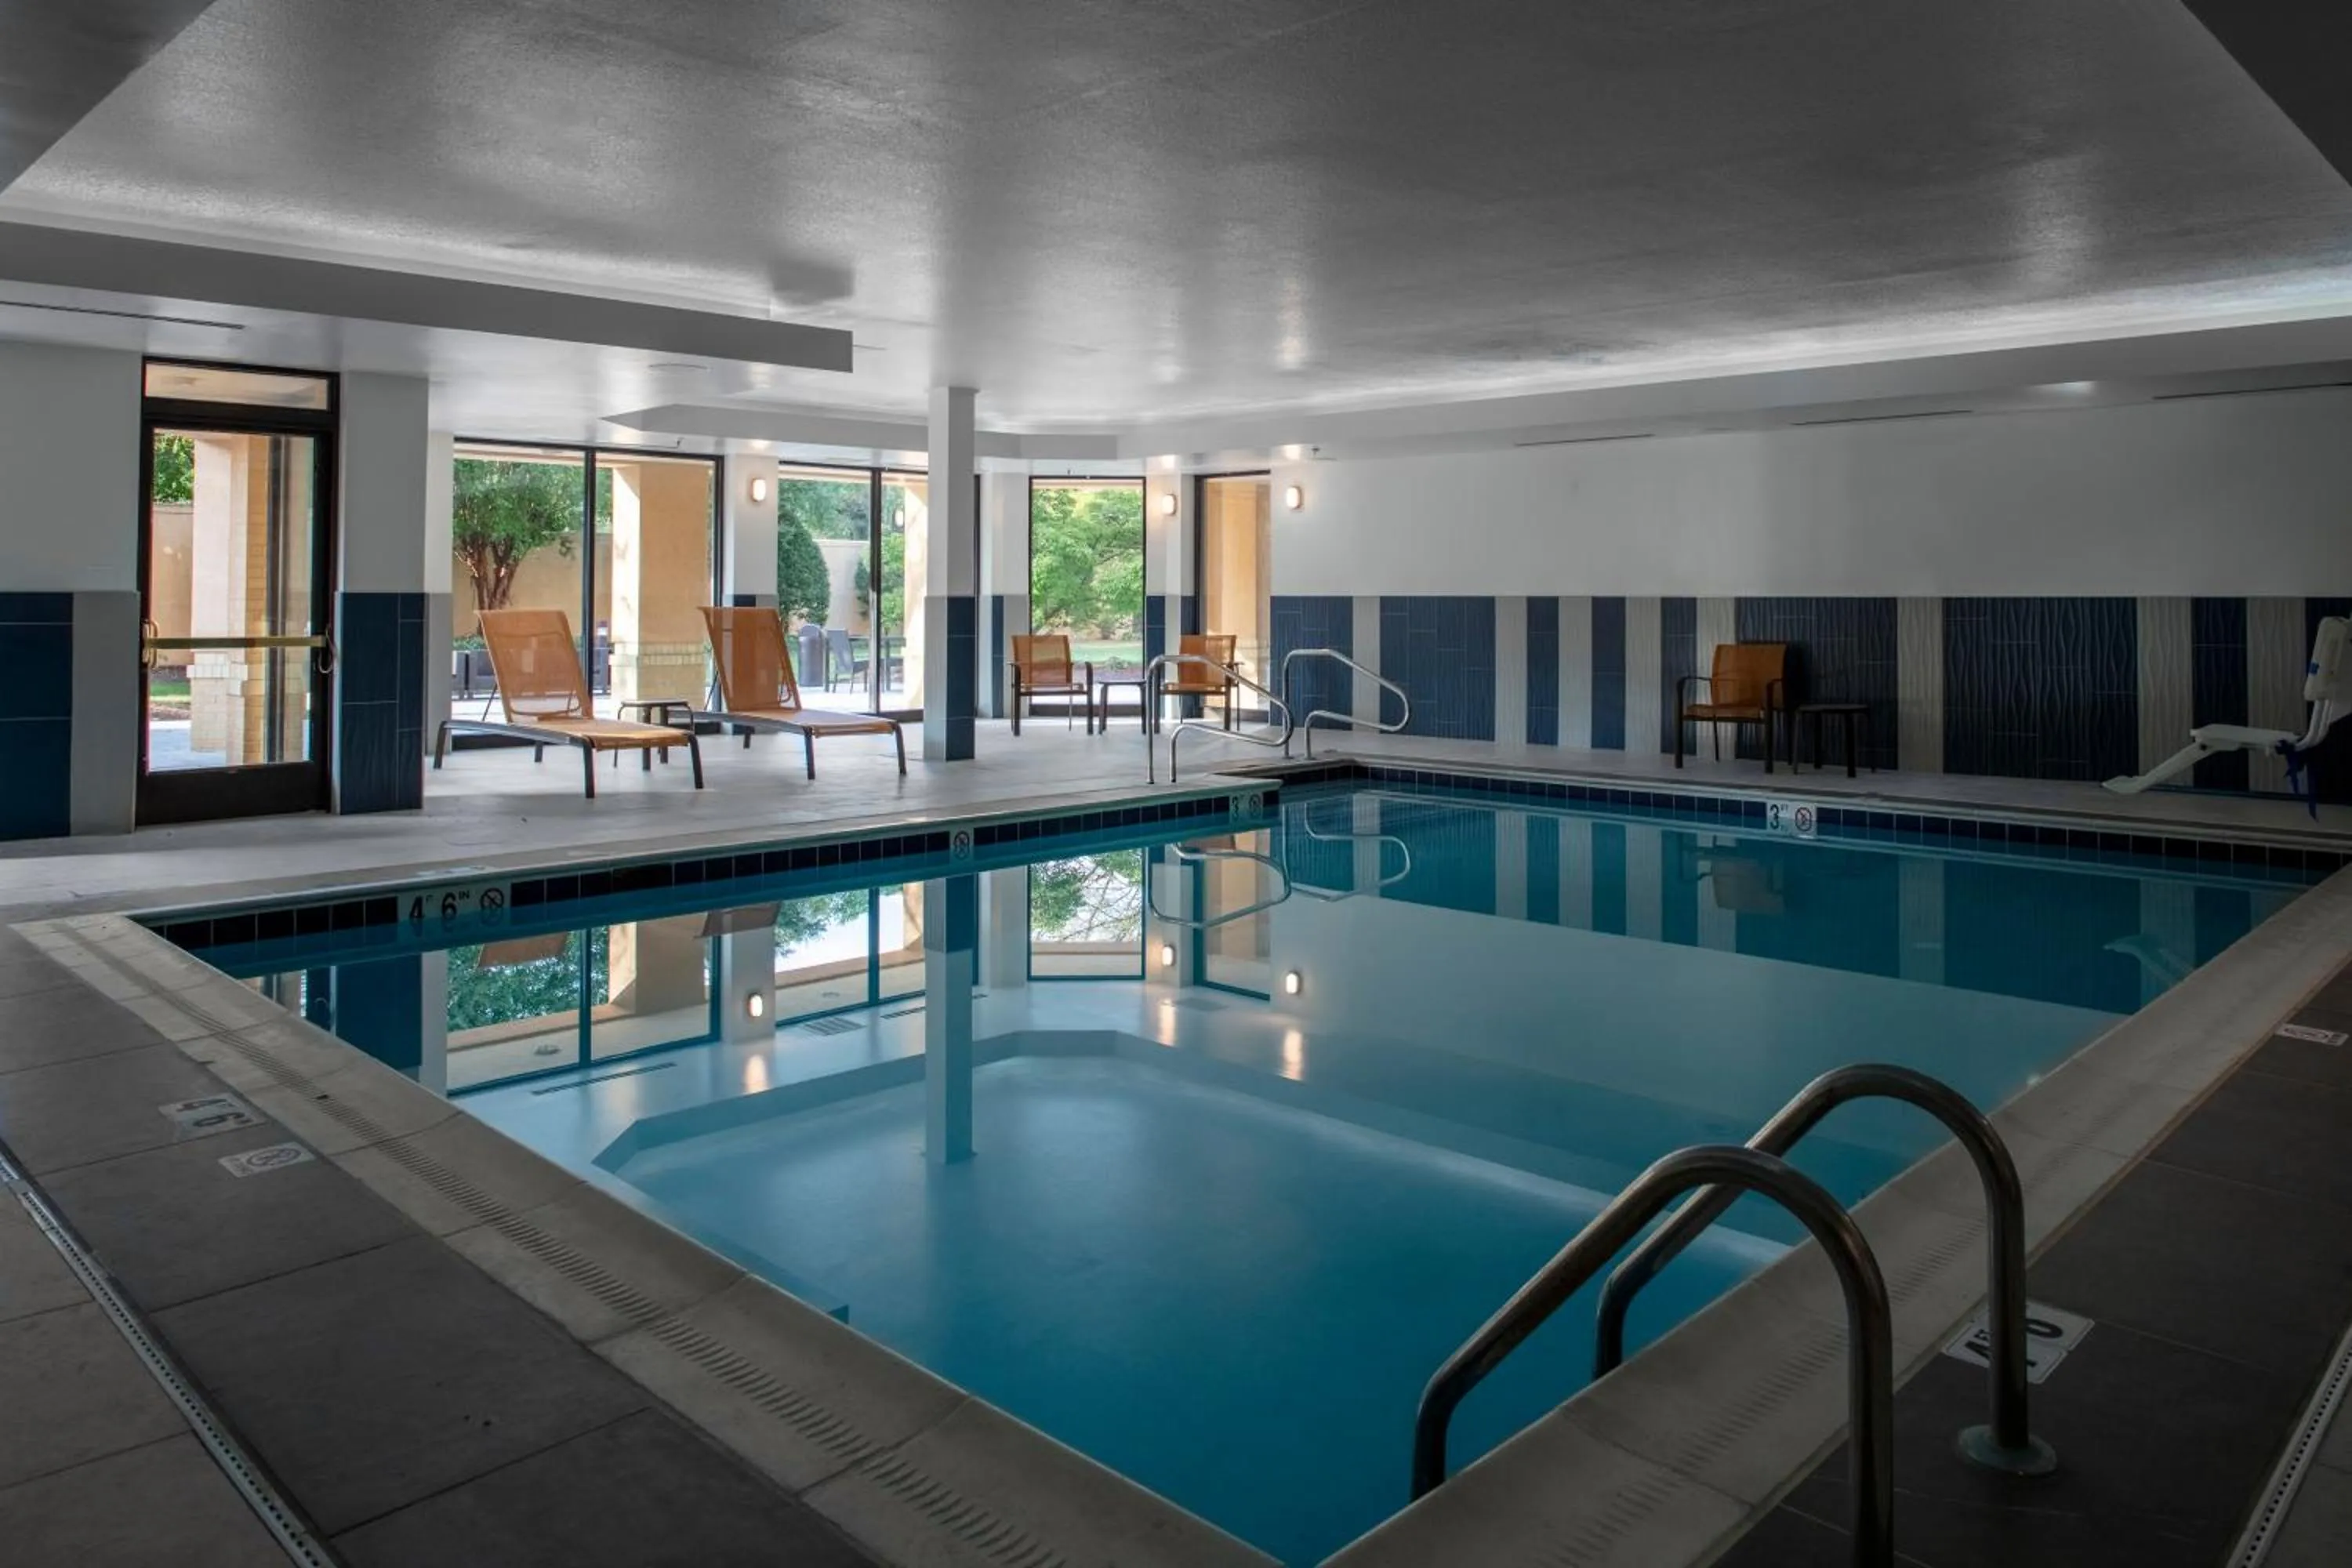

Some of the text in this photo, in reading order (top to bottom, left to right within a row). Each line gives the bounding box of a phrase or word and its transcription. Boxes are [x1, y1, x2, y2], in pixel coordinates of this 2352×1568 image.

[1769, 804, 1779, 829] 3
[409, 895, 424, 919] 4
[441, 891, 457, 920] 6
[459, 890, 470, 900] IN
[193, 1112, 245, 1127] 6
